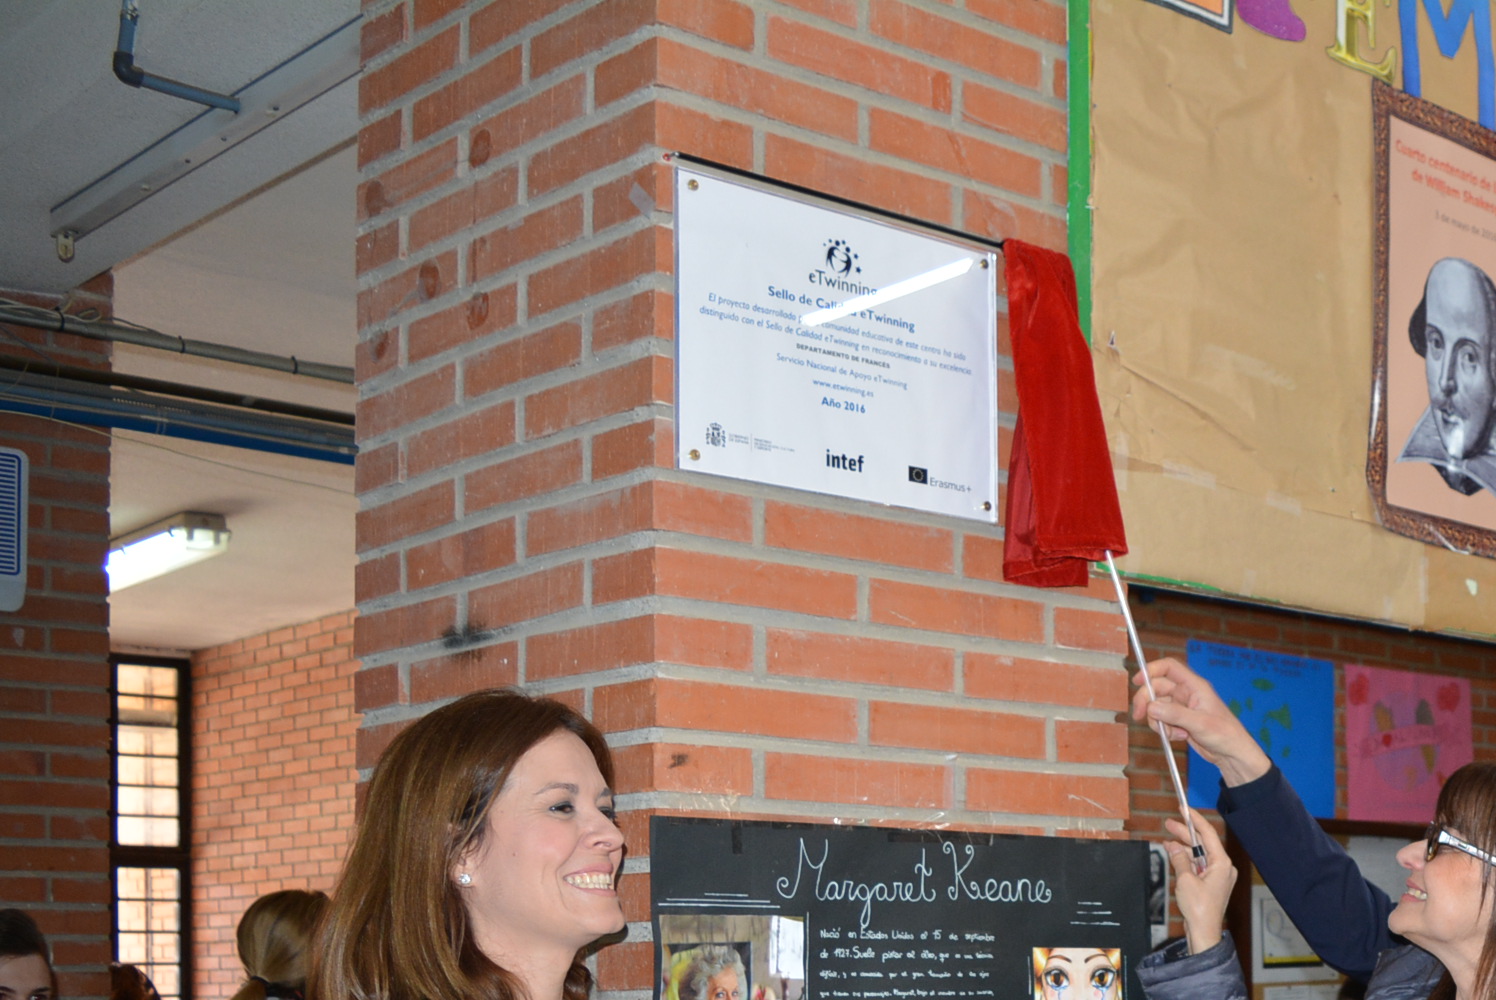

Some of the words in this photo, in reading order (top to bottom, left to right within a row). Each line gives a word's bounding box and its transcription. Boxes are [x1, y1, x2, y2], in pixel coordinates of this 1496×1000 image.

[1395, 138, 1427, 164] Cuarto
[1429, 156, 1478, 187] centenario
[1480, 176, 1491, 192] de
[1412, 169, 1424, 184] de
[1425, 174, 1461, 200] William
[708, 292, 717, 303] El
[718, 295, 750, 312] proyecto
[752, 303, 797, 321] desarrollado
[768, 285, 796, 302] Sello
[798, 293, 812, 306] de
[860, 309, 915, 333] eTwinning
[699, 306, 740, 321] distinguido
[741, 316, 755, 326] con
[756, 317, 764, 327] el
[766, 320, 783, 332] Sello
[784, 325, 794, 335] de
[795, 327, 823, 342] Calidad
[824, 334, 860, 351] eTwinning
[861, 344, 870, 352] en
[871, 345, 921, 364] reconocimiento
[929, 360, 938, 369] su
[796, 342, 850, 360] DEPARTAMENTO
[851, 354, 860, 362] DE
[821, 322, 860, 336] comunidad
[861, 327, 893, 344] educativa
[895, 337, 904, 347] de
[905, 340, 919, 351] este
[920, 343, 941, 356] centro
[943, 347, 952, 358] ha
[953, 350, 966, 362] sido
[776, 352, 805, 366] Servicio
[806, 359, 837, 373] Nacional
[838, 366, 847, 376] de
[849, 369, 872, 382] Apoyo
[873, 374, 908, 391] eTwinning
[812, 378, 874, 398] www.etwinning.es
[821, 396, 842, 409] Año
[843, 401, 866, 414] 2016
[826, 448, 865, 473] intef
[777, 837, 936, 928] Margaret
[942, 841, 1052, 903] Keane
[819, 926, 841, 940] Nació
[847, 931, 858, 940] en
[860, 926, 889, 940] Estados
[892, 930, 915, 940] Unidos
[920, 930, 929, 941] el
[932, 929, 943, 941] 15
[948, 931, 959, 942] de
[964, 932, 996, 943] septiembre
[819, 947, 829, 959] de
[906, 950, 917, 959] al
